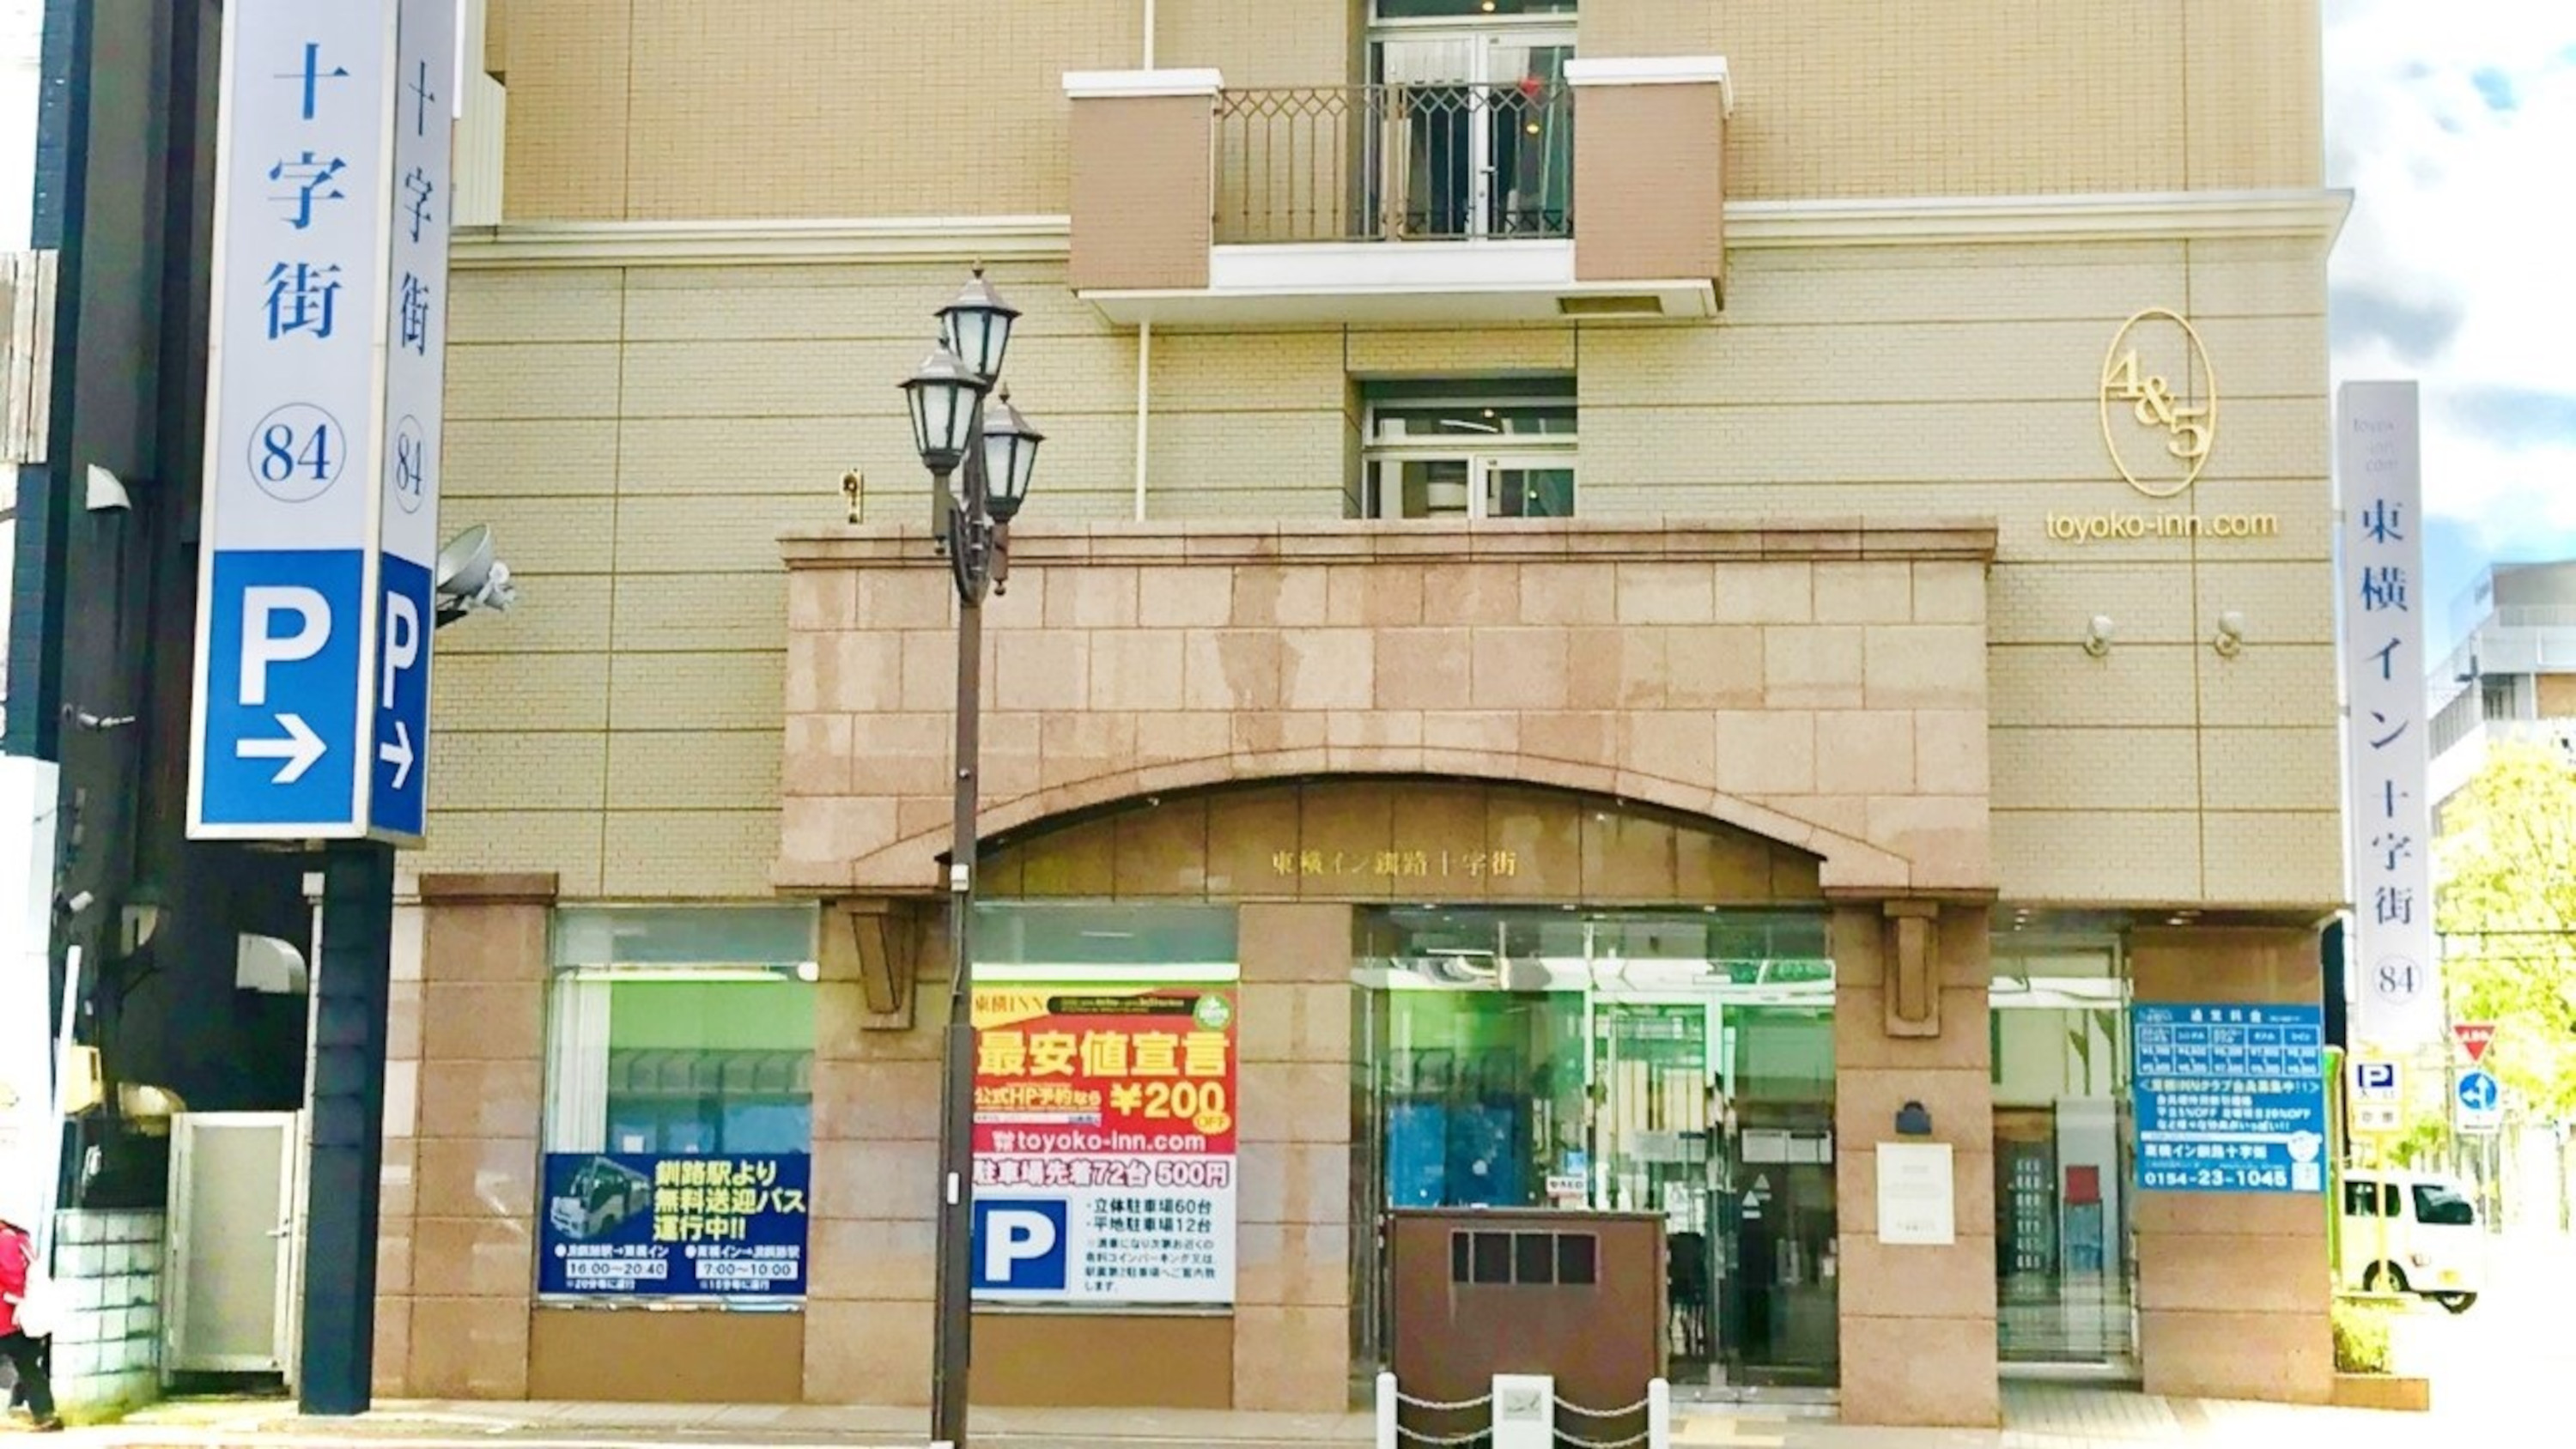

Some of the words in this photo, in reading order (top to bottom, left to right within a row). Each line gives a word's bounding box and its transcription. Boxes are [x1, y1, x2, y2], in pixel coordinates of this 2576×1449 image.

[261, 43, 349, 340] 十字街
[400, 59, 435, 356] 十字街
[261, 424, 331, 482] 84
[396, 433, 423, 496] 84
[2045, 511, 2279, 545] toyoko-inn.com
[238, 585, 332, 706] P
[383, 590, 420, 710] P
[2379, 965, 2415, 994] 84
[977, 1030, 1230, 1076] 最安値宣言
[2363, 1064, 2390, 1089] P
[1110, 1081, 1226, 1119] ¥200
[1196, 1115, 1226, 1129] OFF
[1018, 1131, 1206, 1154] toyoko-inn.com
[654, 1161, 777, 1186] 釧路駅より
[972, 1158, 1151, 1188] 駐車場先着72台
[1154, 1159, 1230, 1187] 500円
[2144, 1168, 2287, 1187] 0154-23-1045
[653, 1187, 806, 1214] 無料送迎バス
[985, 1210, 1057, 1282] P
